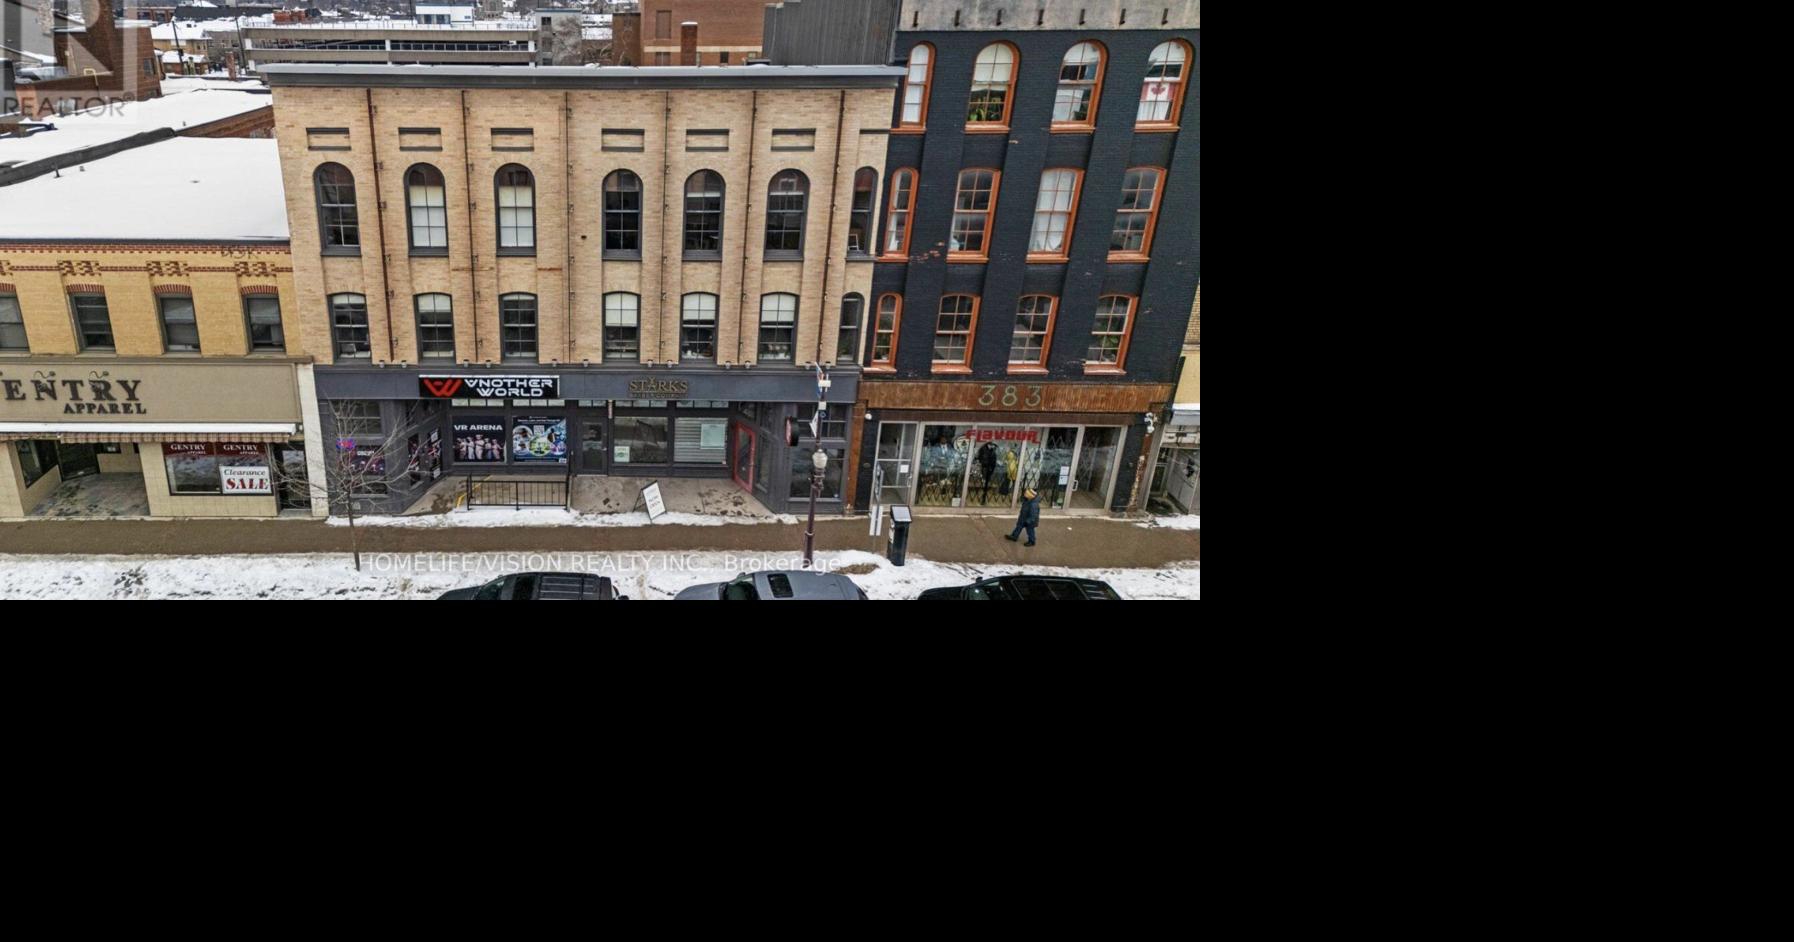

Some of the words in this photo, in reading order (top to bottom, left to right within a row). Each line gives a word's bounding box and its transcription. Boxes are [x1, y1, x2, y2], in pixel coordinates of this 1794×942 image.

[629, 377, 688, 392] STARKS
[477, 388, 544, 398] WORLD
[978, 385, 1042, 407] 383
[63, 403, 147, 414] APPAREL
[224, 469, 266, 477] Clearance
[226, 478, 269, 490] SALE
